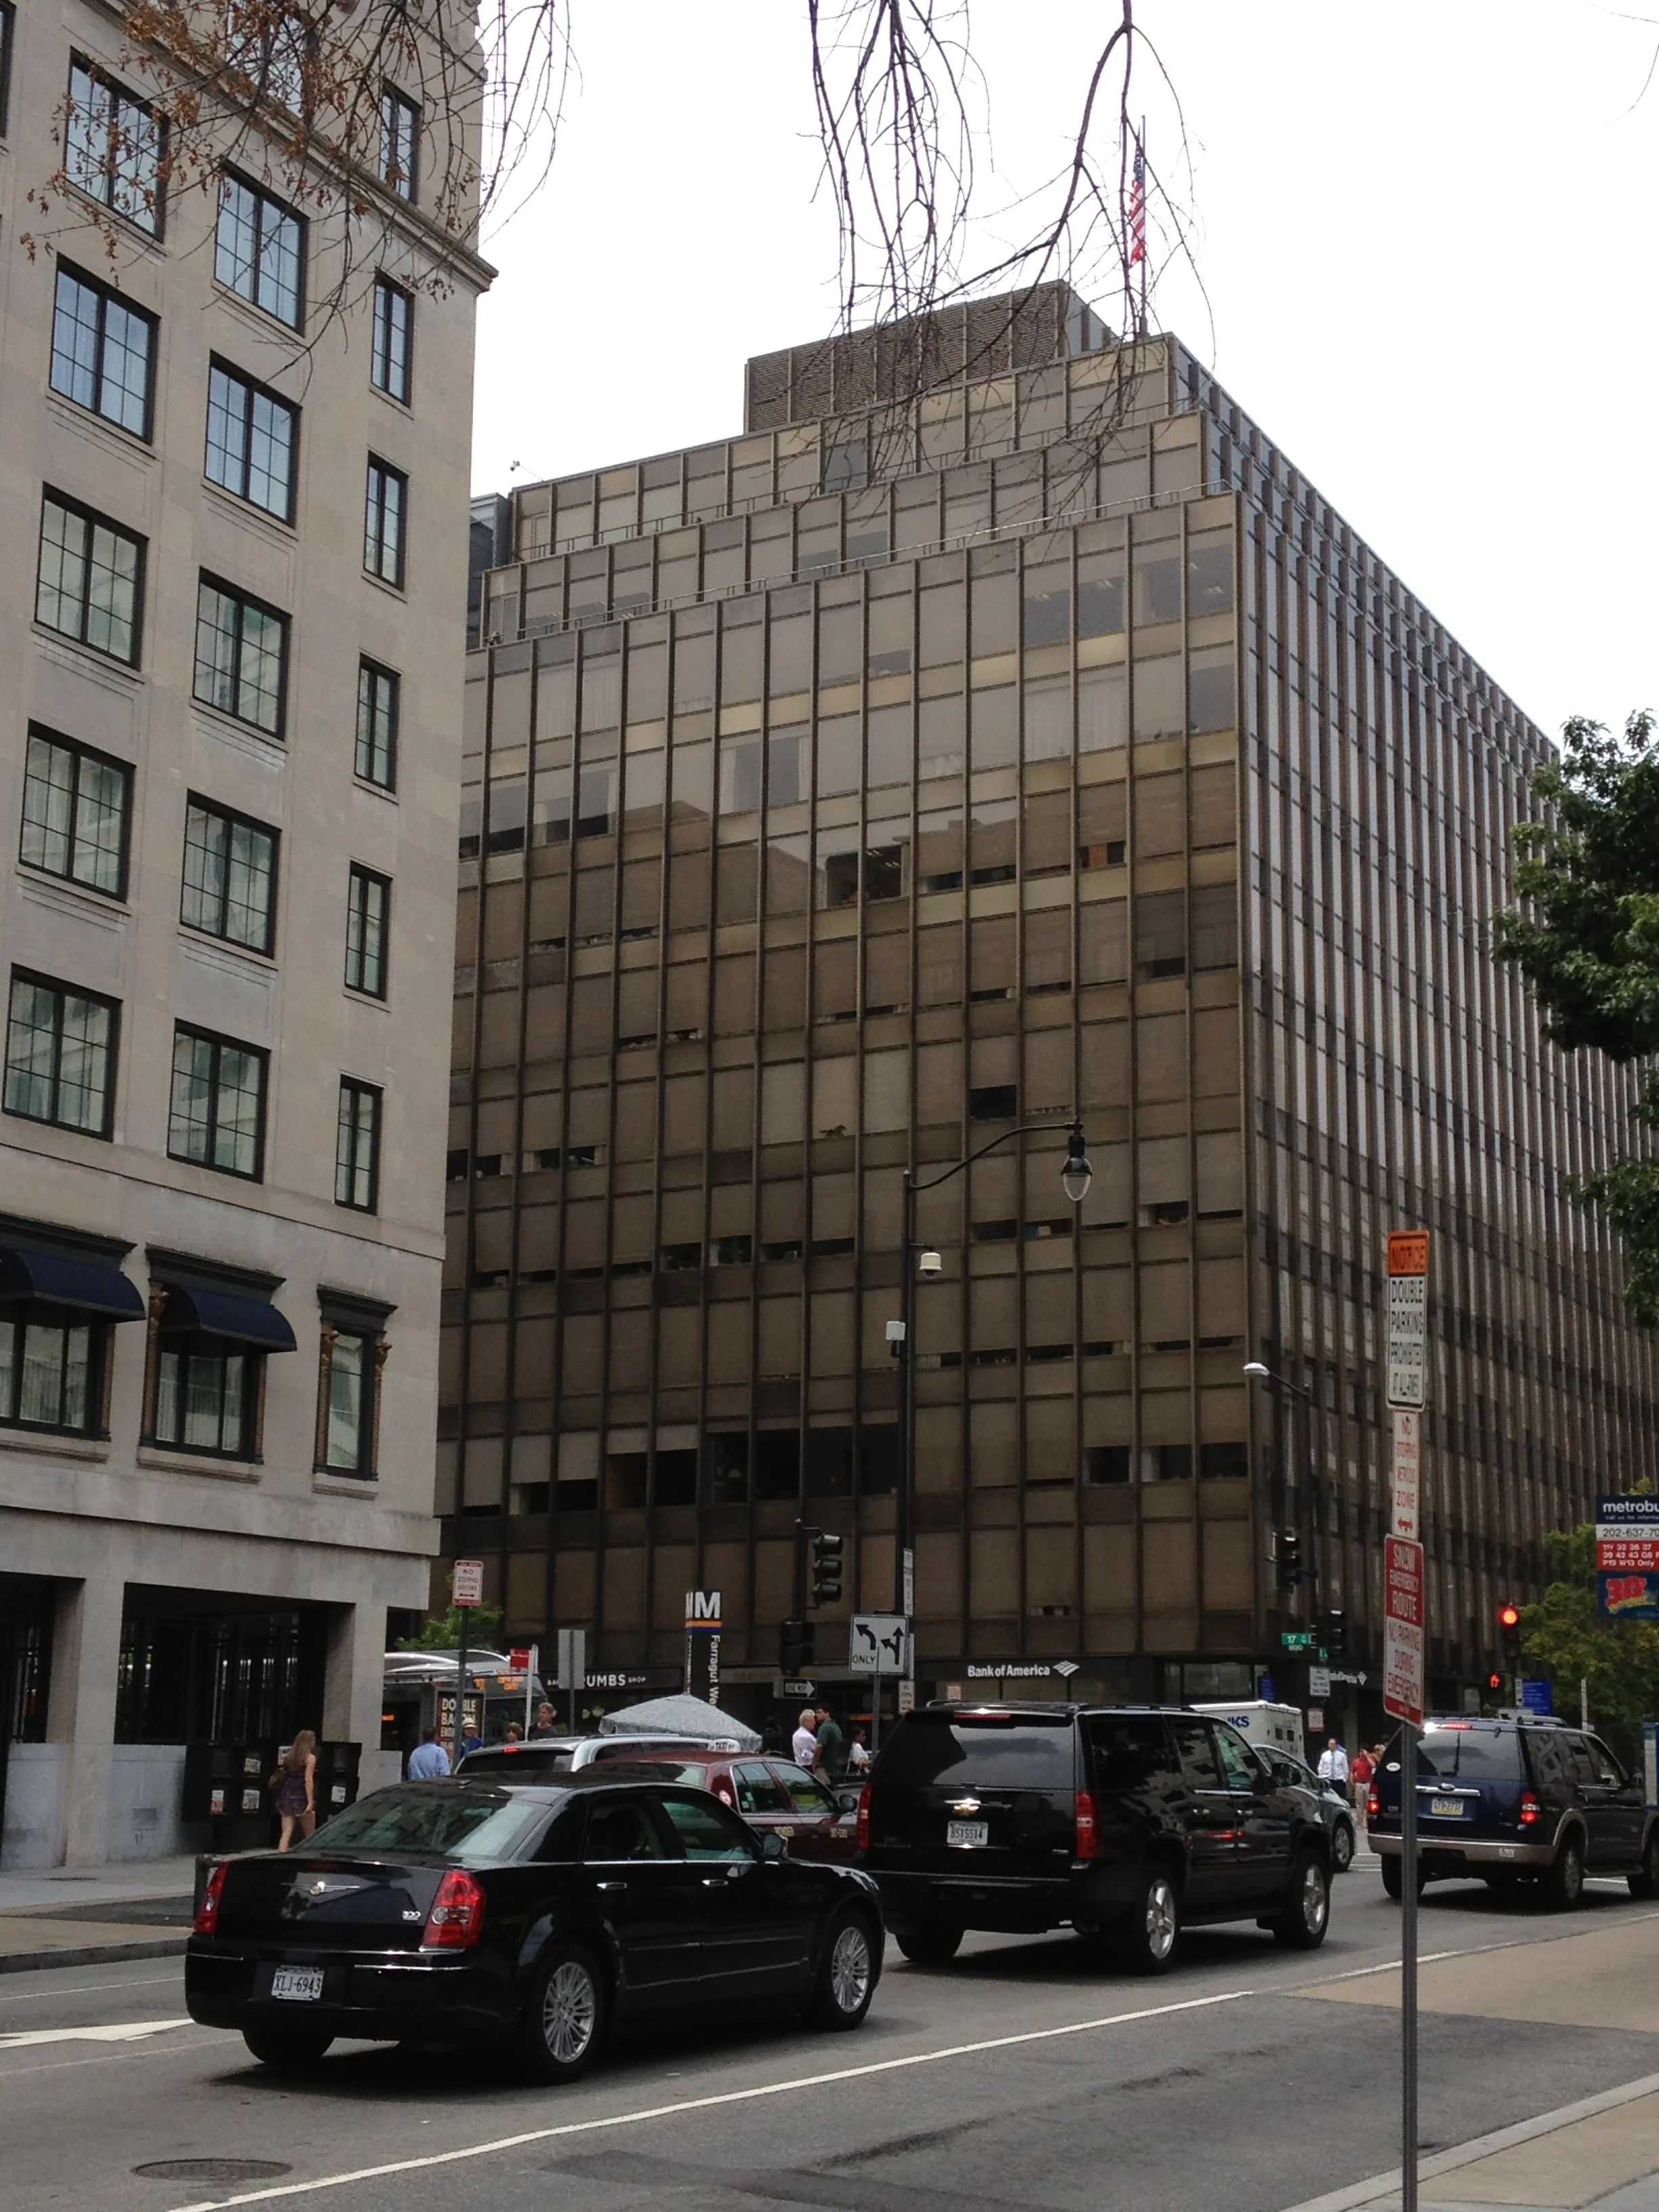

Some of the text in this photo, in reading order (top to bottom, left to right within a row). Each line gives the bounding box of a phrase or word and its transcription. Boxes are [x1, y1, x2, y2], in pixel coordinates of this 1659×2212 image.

[1391, 1279, 1422, 1304] DOUBLE
[1391, 1311, 1422, 1334] PARKING
[695, 1592, 720, 1618] M
[1393, 1590, 1416, 1621] ROUTE
[708, 1635, 720, 1683] Farragut
[853, 1654, 876, 1664] ONLY
[968, 1664, 1050, 1677] Bank of America
[584, 1674, 626, 1687] UMBS
[442, 1698, 476, 1712] DOBLE
